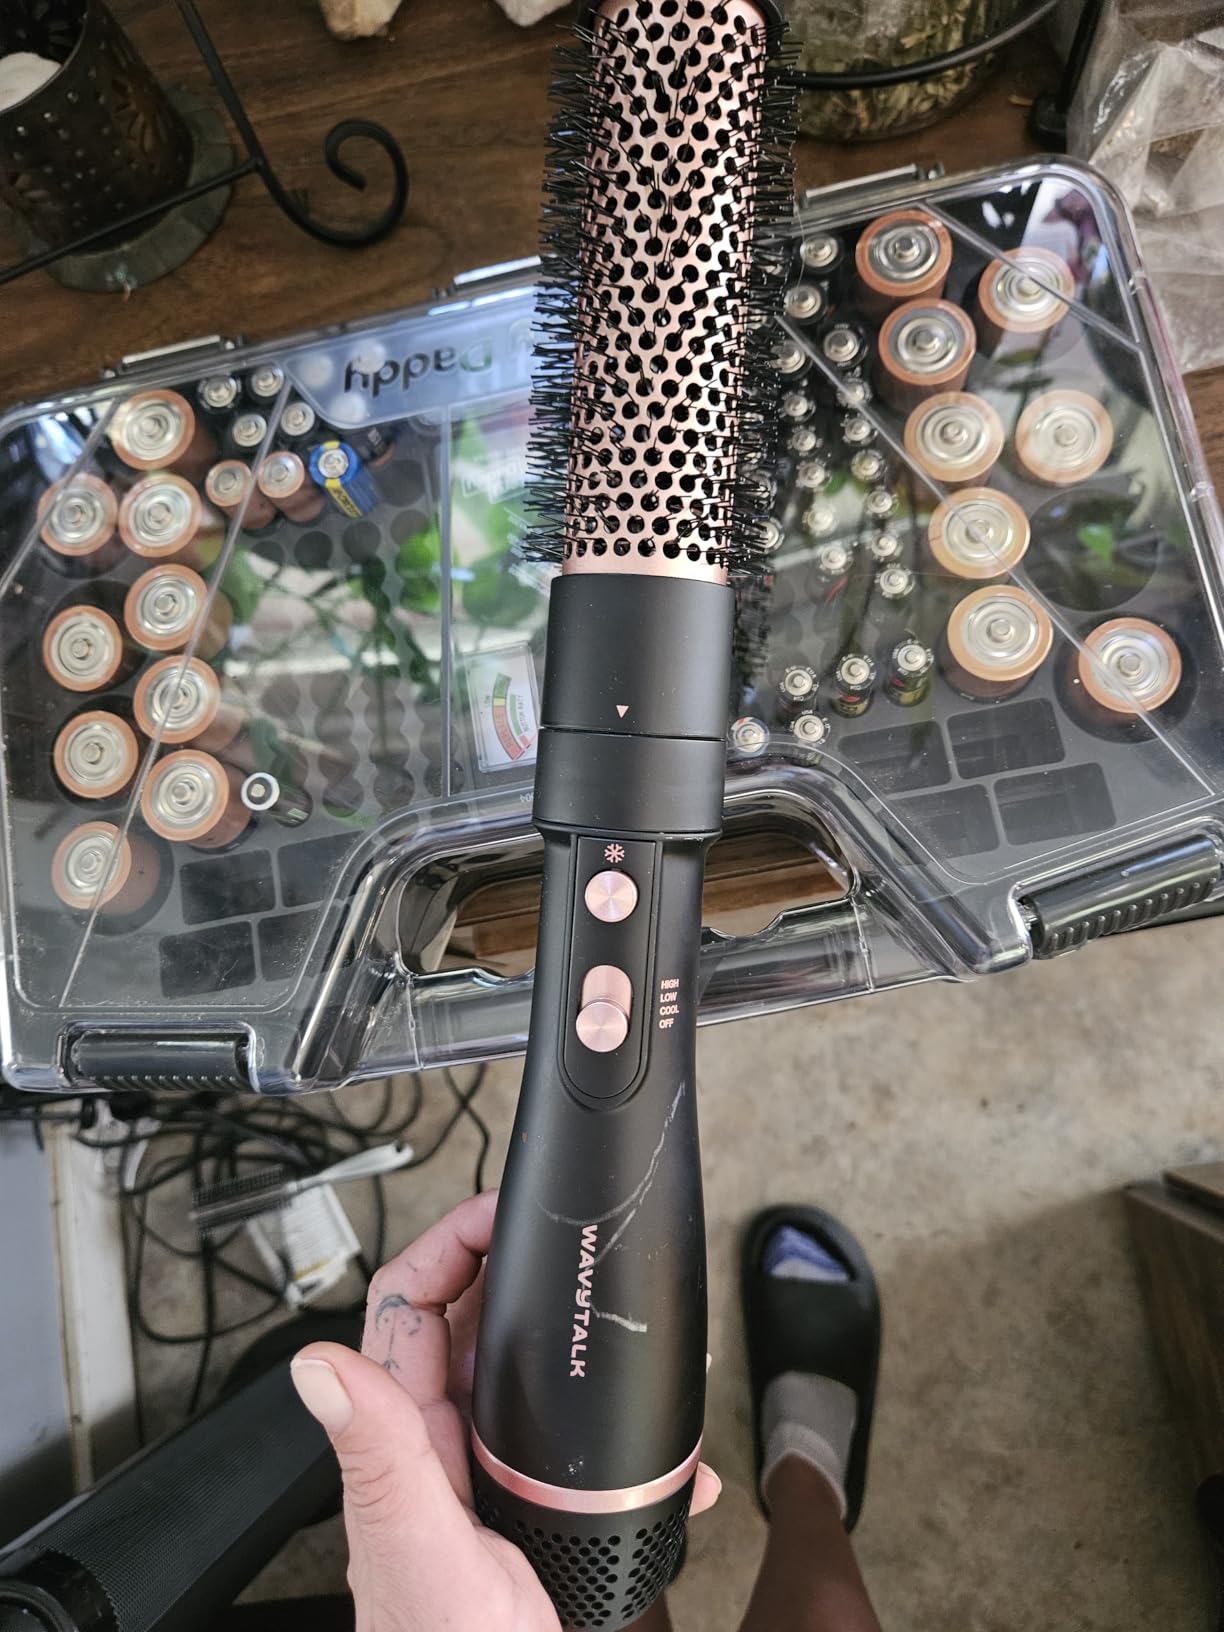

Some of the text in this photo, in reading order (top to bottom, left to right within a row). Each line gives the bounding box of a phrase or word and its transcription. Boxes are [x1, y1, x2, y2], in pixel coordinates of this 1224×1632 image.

[344, 343, 493, 398] Daddy
[661, 978, 680, 990] HIGH
[660, 991, 678, 1003] LOW
[659, 1004, 680, 1016] COOL
[659, 1017, 675, 1029] OFF
